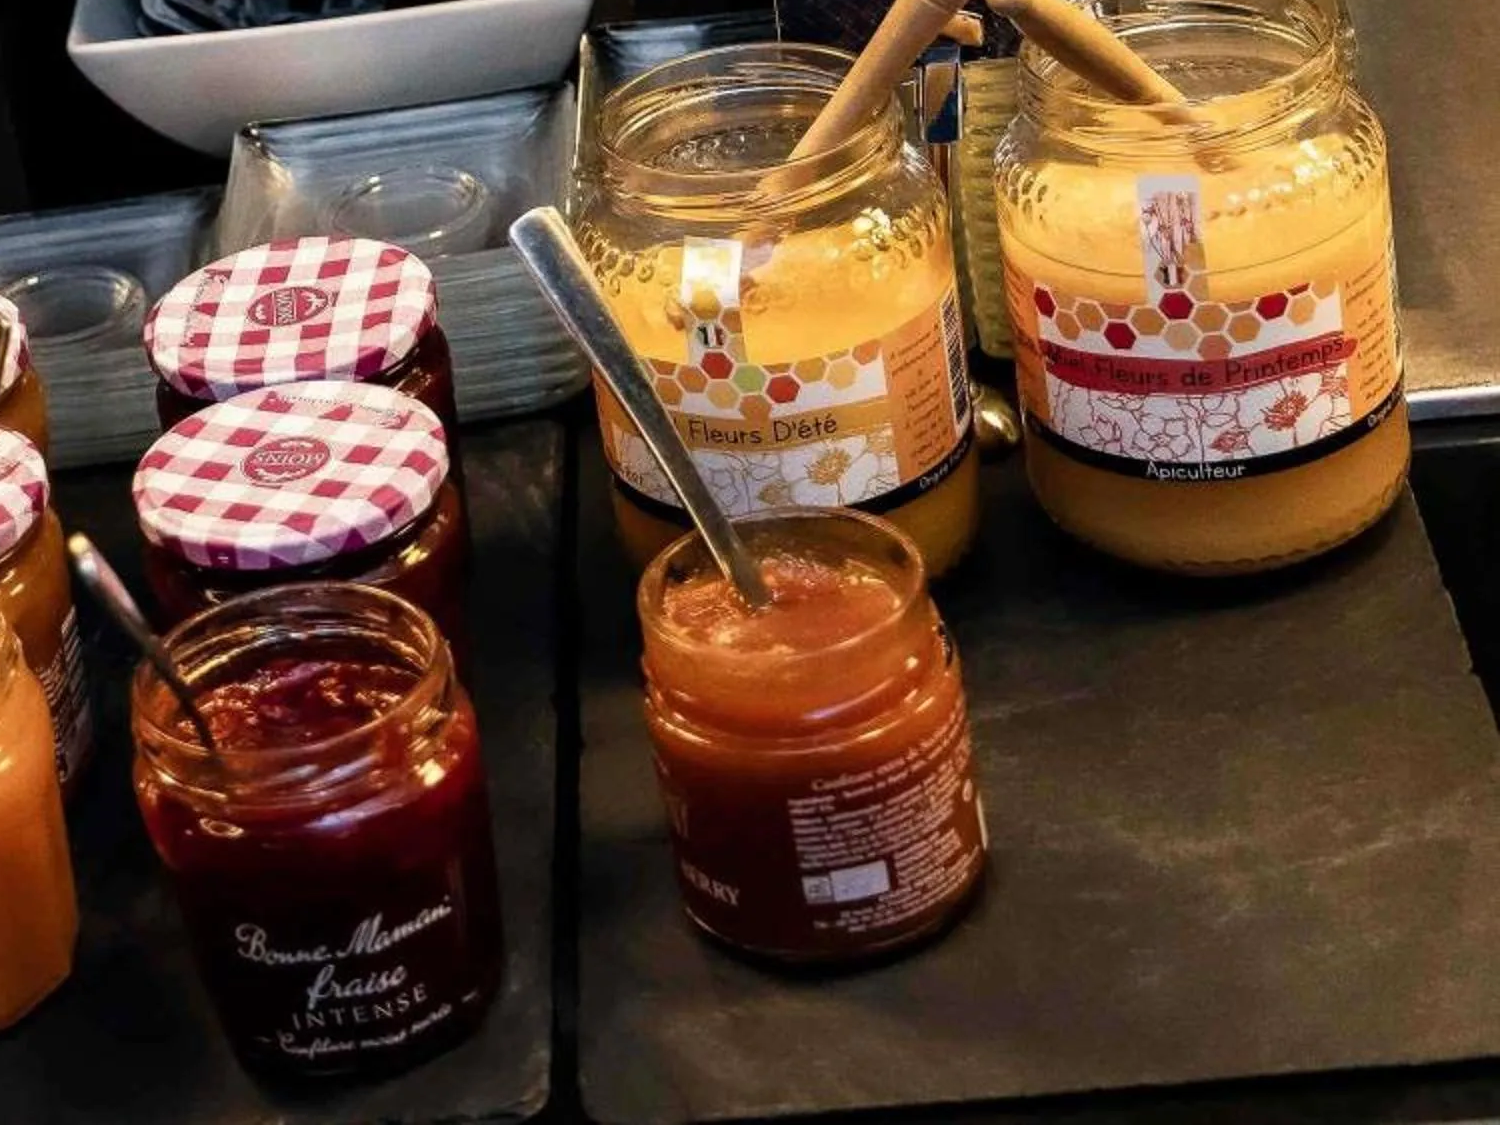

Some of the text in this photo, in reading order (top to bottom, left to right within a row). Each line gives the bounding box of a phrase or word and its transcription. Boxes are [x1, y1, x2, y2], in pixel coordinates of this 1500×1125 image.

[1181, 366, 1214, 387] de
[1225, 338, 1344, 386] Printemps
[688, 414, 838, 445] Fleurs D'été
[1146, 461, 1249, 481] Apiculteur
[235, 897, 453, 966] Bonne Maman
[293, 983, 428, 1030] INTENSE
[307, 964, 408, 1010] fraise
